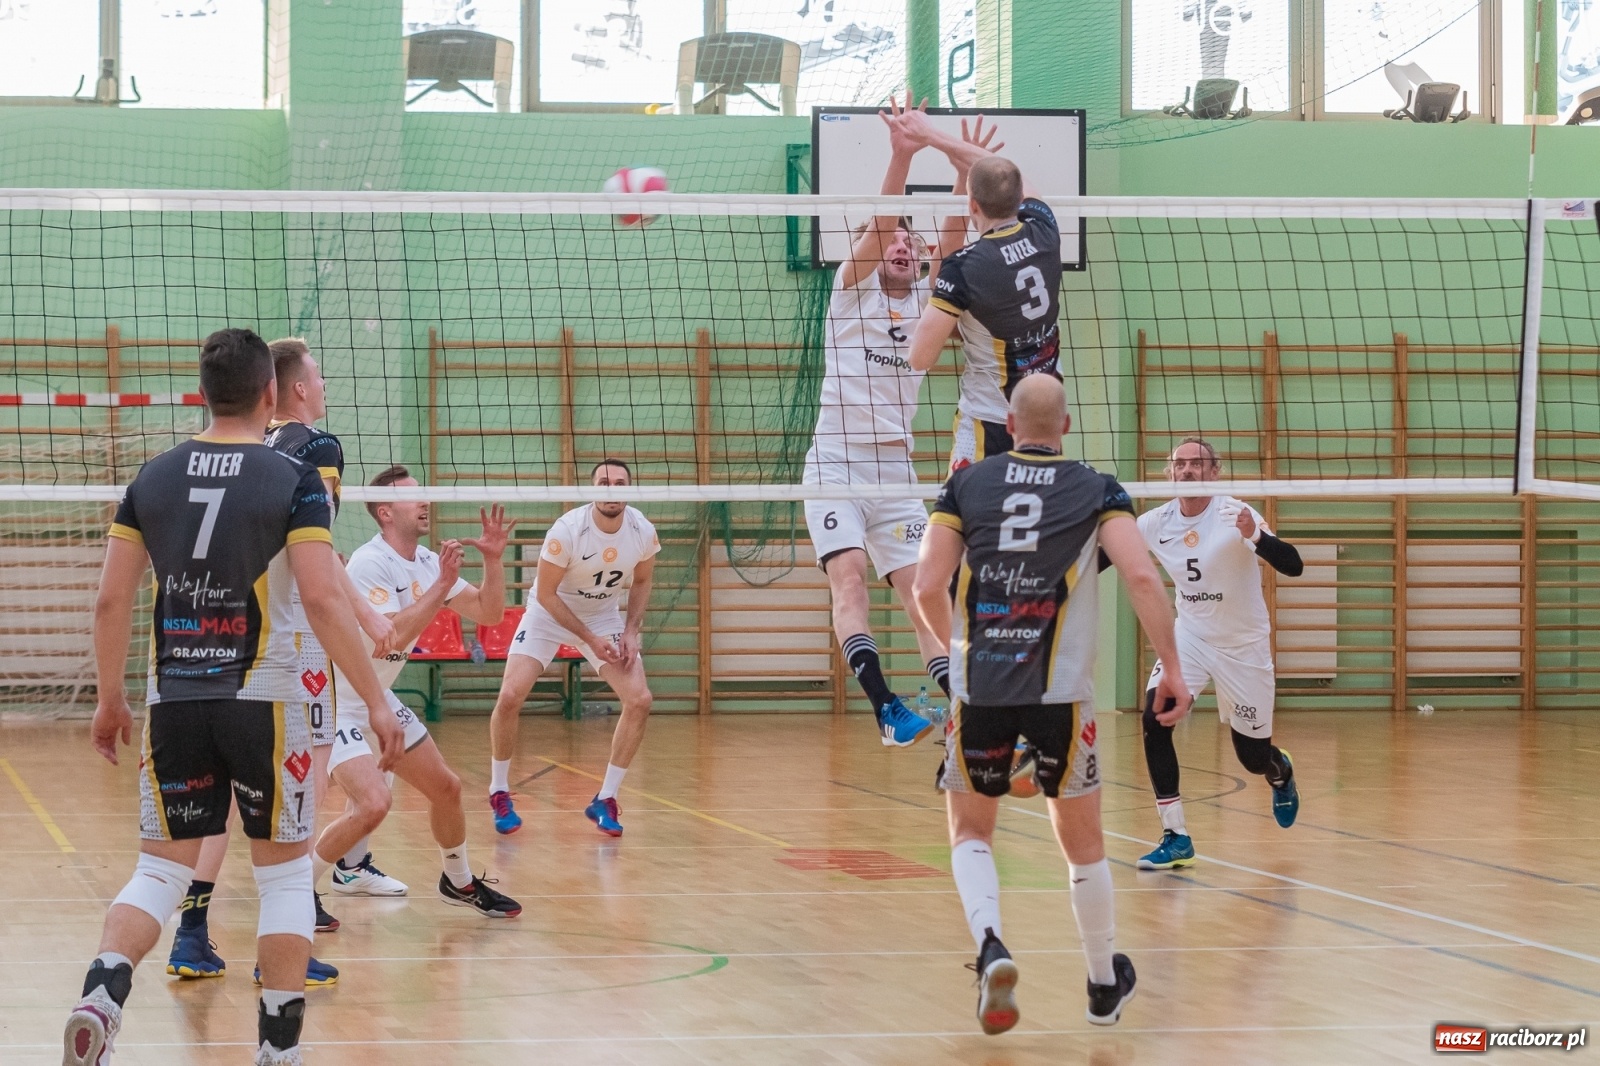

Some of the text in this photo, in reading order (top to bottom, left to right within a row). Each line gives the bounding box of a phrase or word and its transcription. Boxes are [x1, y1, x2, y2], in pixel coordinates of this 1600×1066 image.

[1000, 238, 1038, 265] ENTER
[1014, 265, 1050, 320] 3
[187, 451, 244, 477] ENTER
[1004, 462, 1056, 485] ENTER
[189, 487, 226, 559] 7
[823, 511, 838, 530] 6
[998, 492, 1043, 552] 2
[592, 570, 624, 588] 12
[1186, 558, 1202, 582] 5
[984, 628, 1042, 639] GRAVTON
[172, 647, 237, 658] GRAVTON
[1234, 702, 1257, 713] ZOO
[335, 727, 363, 745] 16
[294, 790, 305, 824] 7
